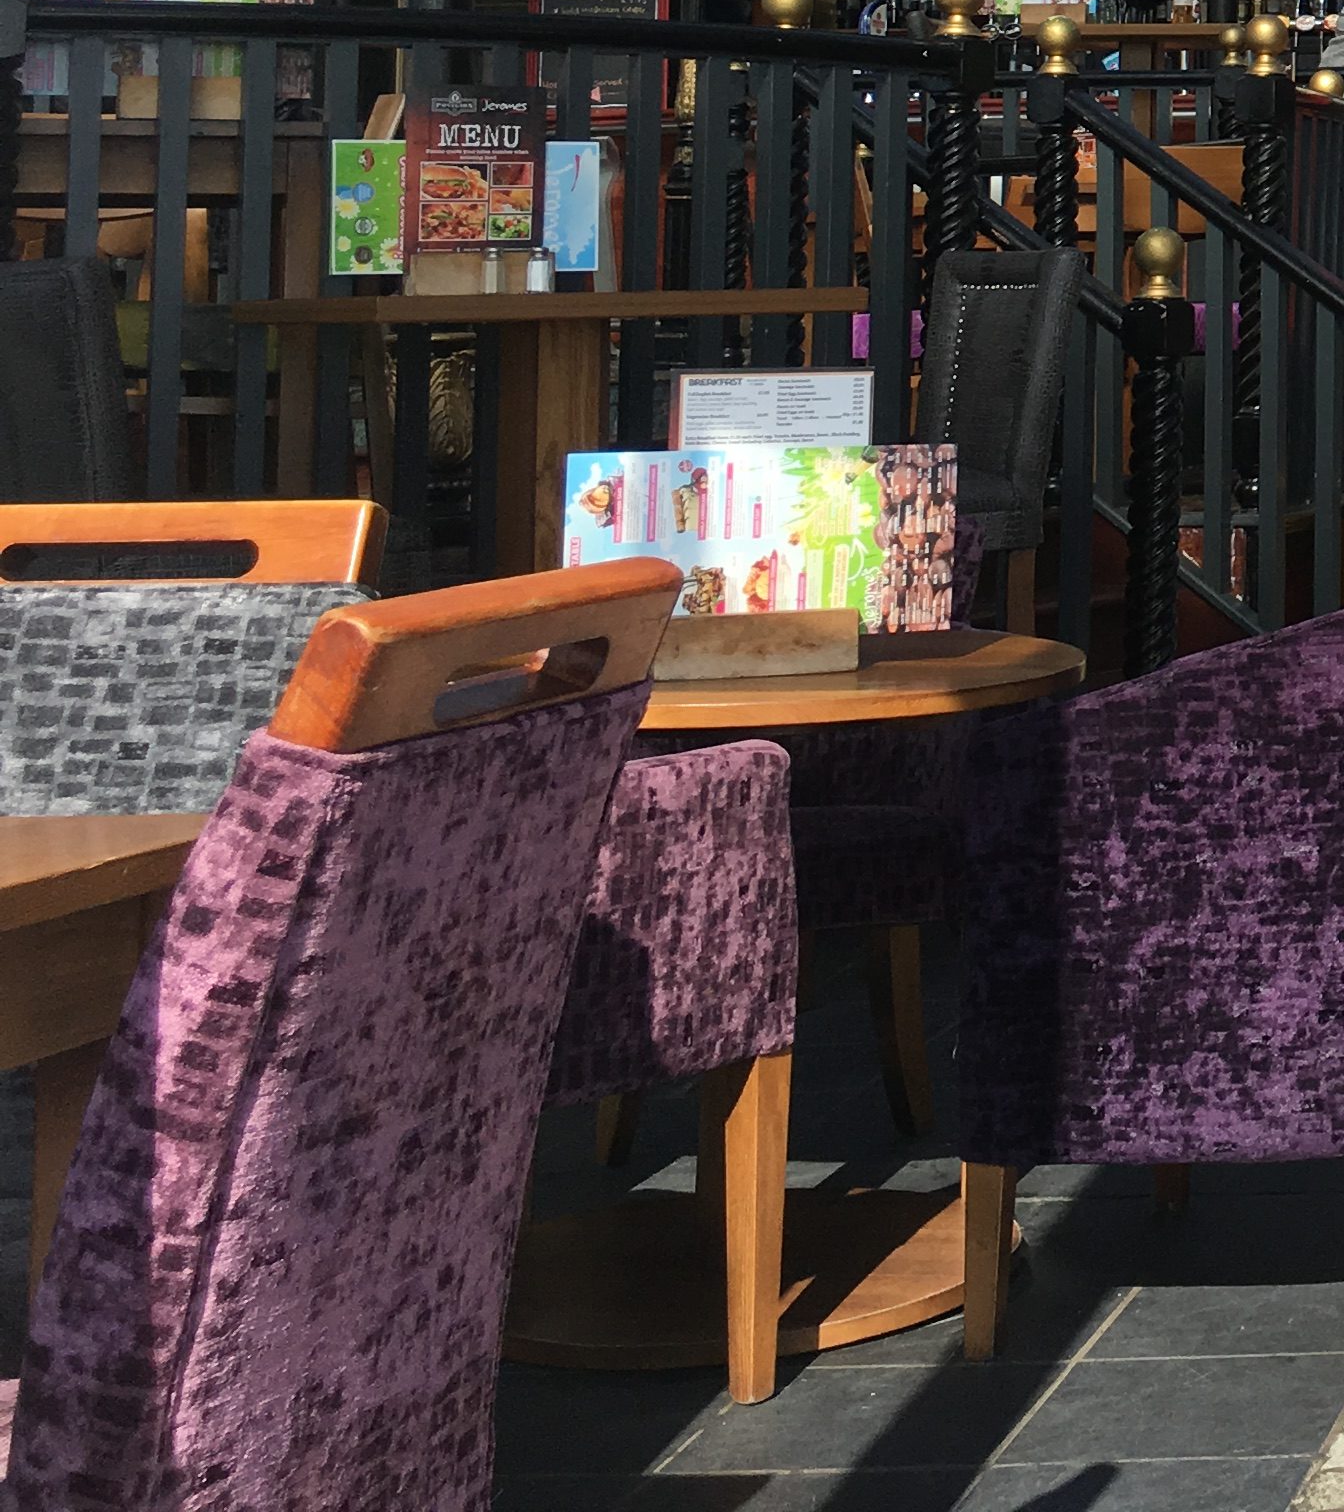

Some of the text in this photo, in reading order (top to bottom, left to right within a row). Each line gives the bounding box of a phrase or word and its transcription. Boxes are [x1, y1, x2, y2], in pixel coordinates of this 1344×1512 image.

[437, 123, 522, 148] MENU
[688, 377, 743, 386] BREAKFAST
[570, 538, 581, 568] TABLE
